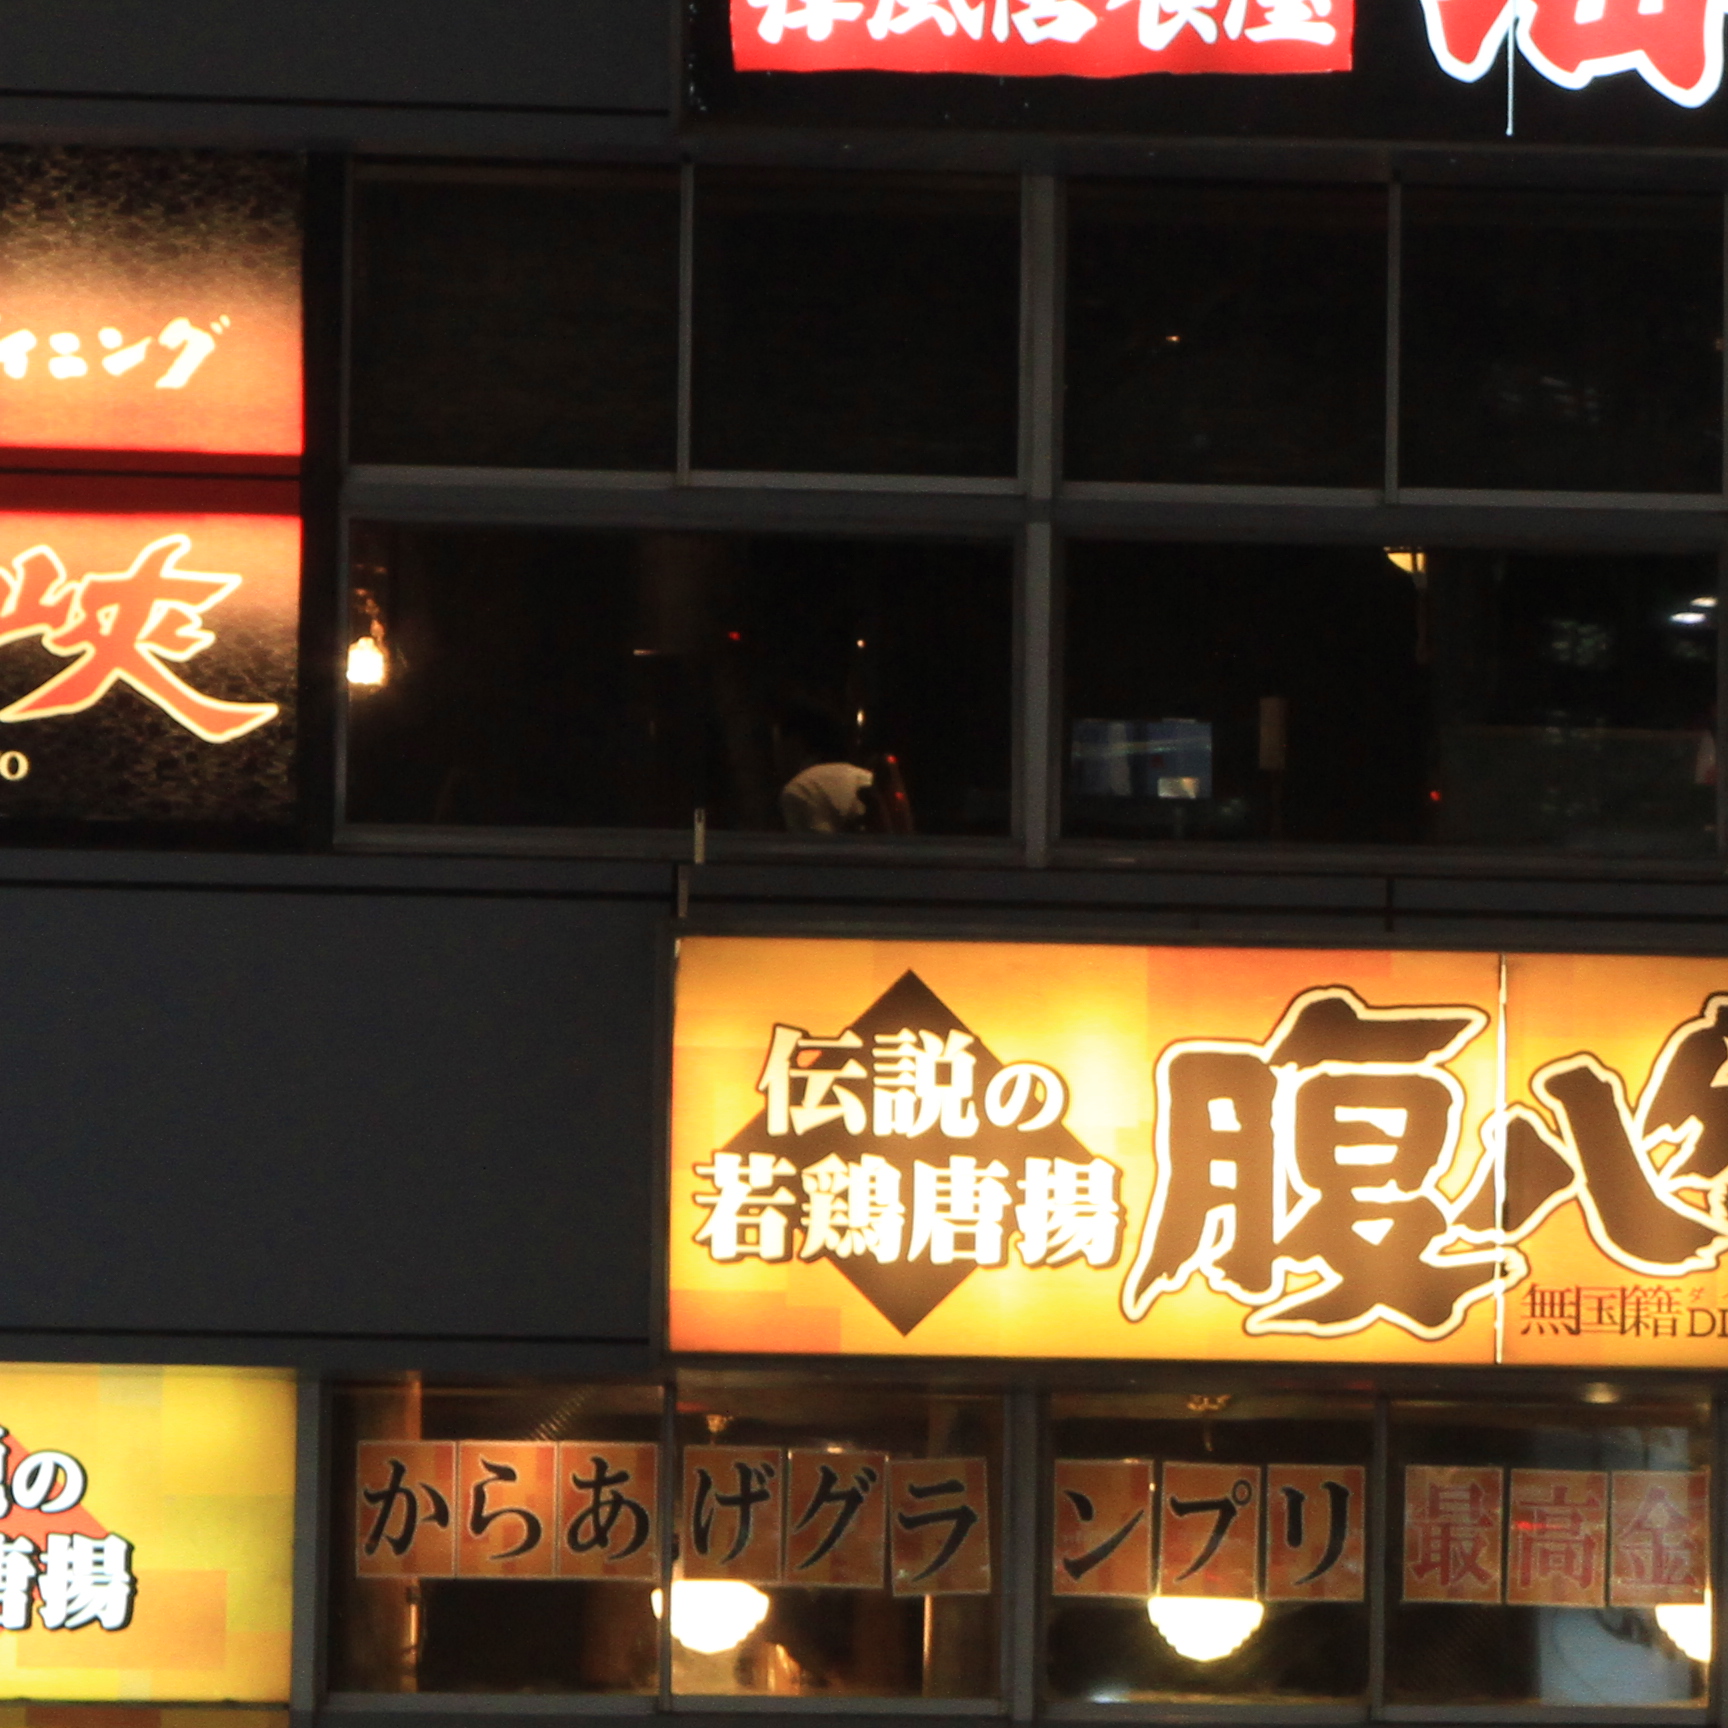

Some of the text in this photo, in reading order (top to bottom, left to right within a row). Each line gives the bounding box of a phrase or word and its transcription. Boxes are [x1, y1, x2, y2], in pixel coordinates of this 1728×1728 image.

[757, 1025, 1067, 1137] 伝説の
[693, 1152, 1128, 1268] 若鶏唐揚
[1520, 1283, 1682, 1340] 無国籍
[362, 1457, 1352, 1586] からあげグランプリ
